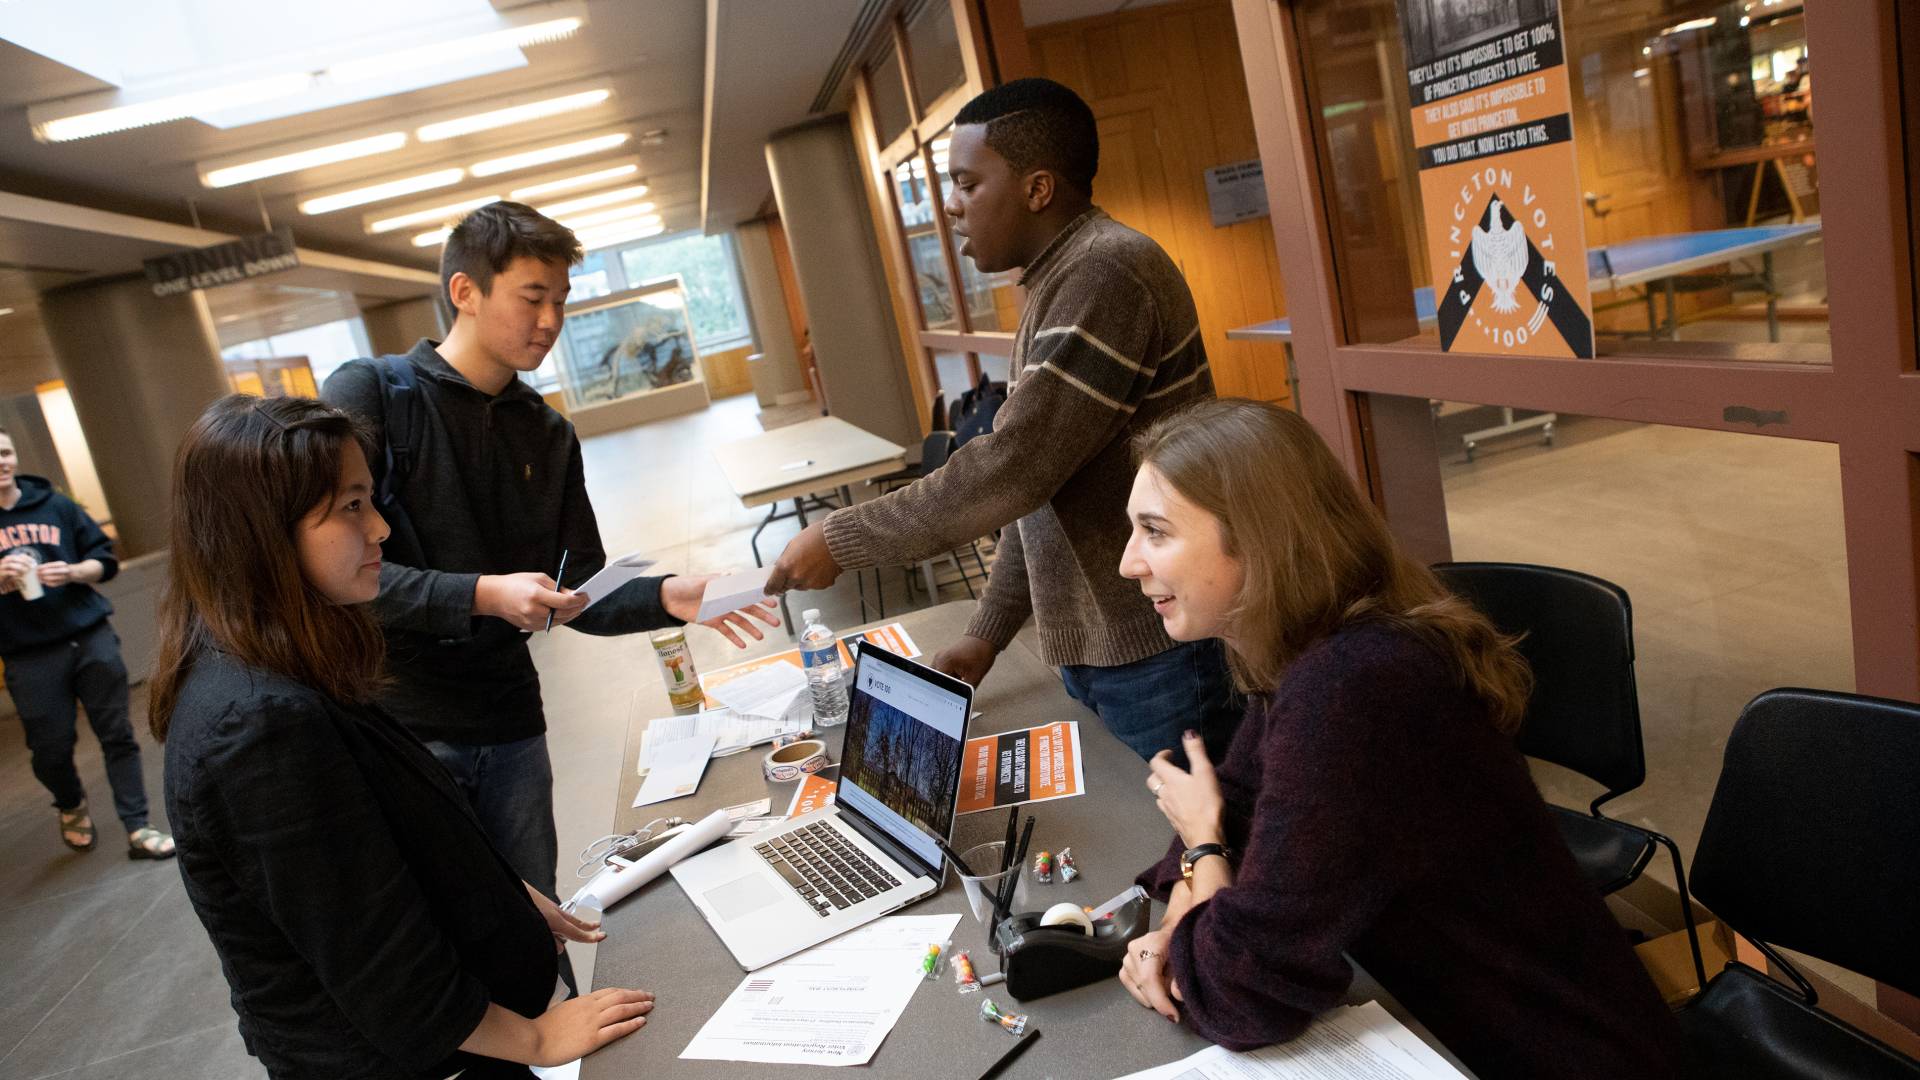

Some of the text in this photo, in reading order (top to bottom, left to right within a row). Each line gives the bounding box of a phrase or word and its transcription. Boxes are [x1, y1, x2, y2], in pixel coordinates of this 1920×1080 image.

[1408, 22, 1555, 86] THEY'LL SAY IT'S IMPOSSIBLE TO GET 100%
[1423, 52, 1540, 102] OF PRINCETON STUDENTS TO VOTE.
[1424, 106, 1441, 125] THEY
[1489, 80, 1534, 107] IMPOSSIBLE
[1534, 76, 1545, 95] TO
[1432, 147, 1447, 164] YOU
[1446, 143, 1458, 160] DID
[1478, 136, 1495, 154] NOW
[1495, 131, 1516, 152] LET'S
[1516, 128, 1527, 146] DO
[1527, 124, 1549, 144] THIS.
[147, 224, 296, 281] DINING
[1451, 168, 1556, 305] PRINCETON VOTES
[152, 252, 298, 297] ONE LEVEL DOWN
[1492, 326, 1528, 347] 100
[800, 795, 816, 813] 100
